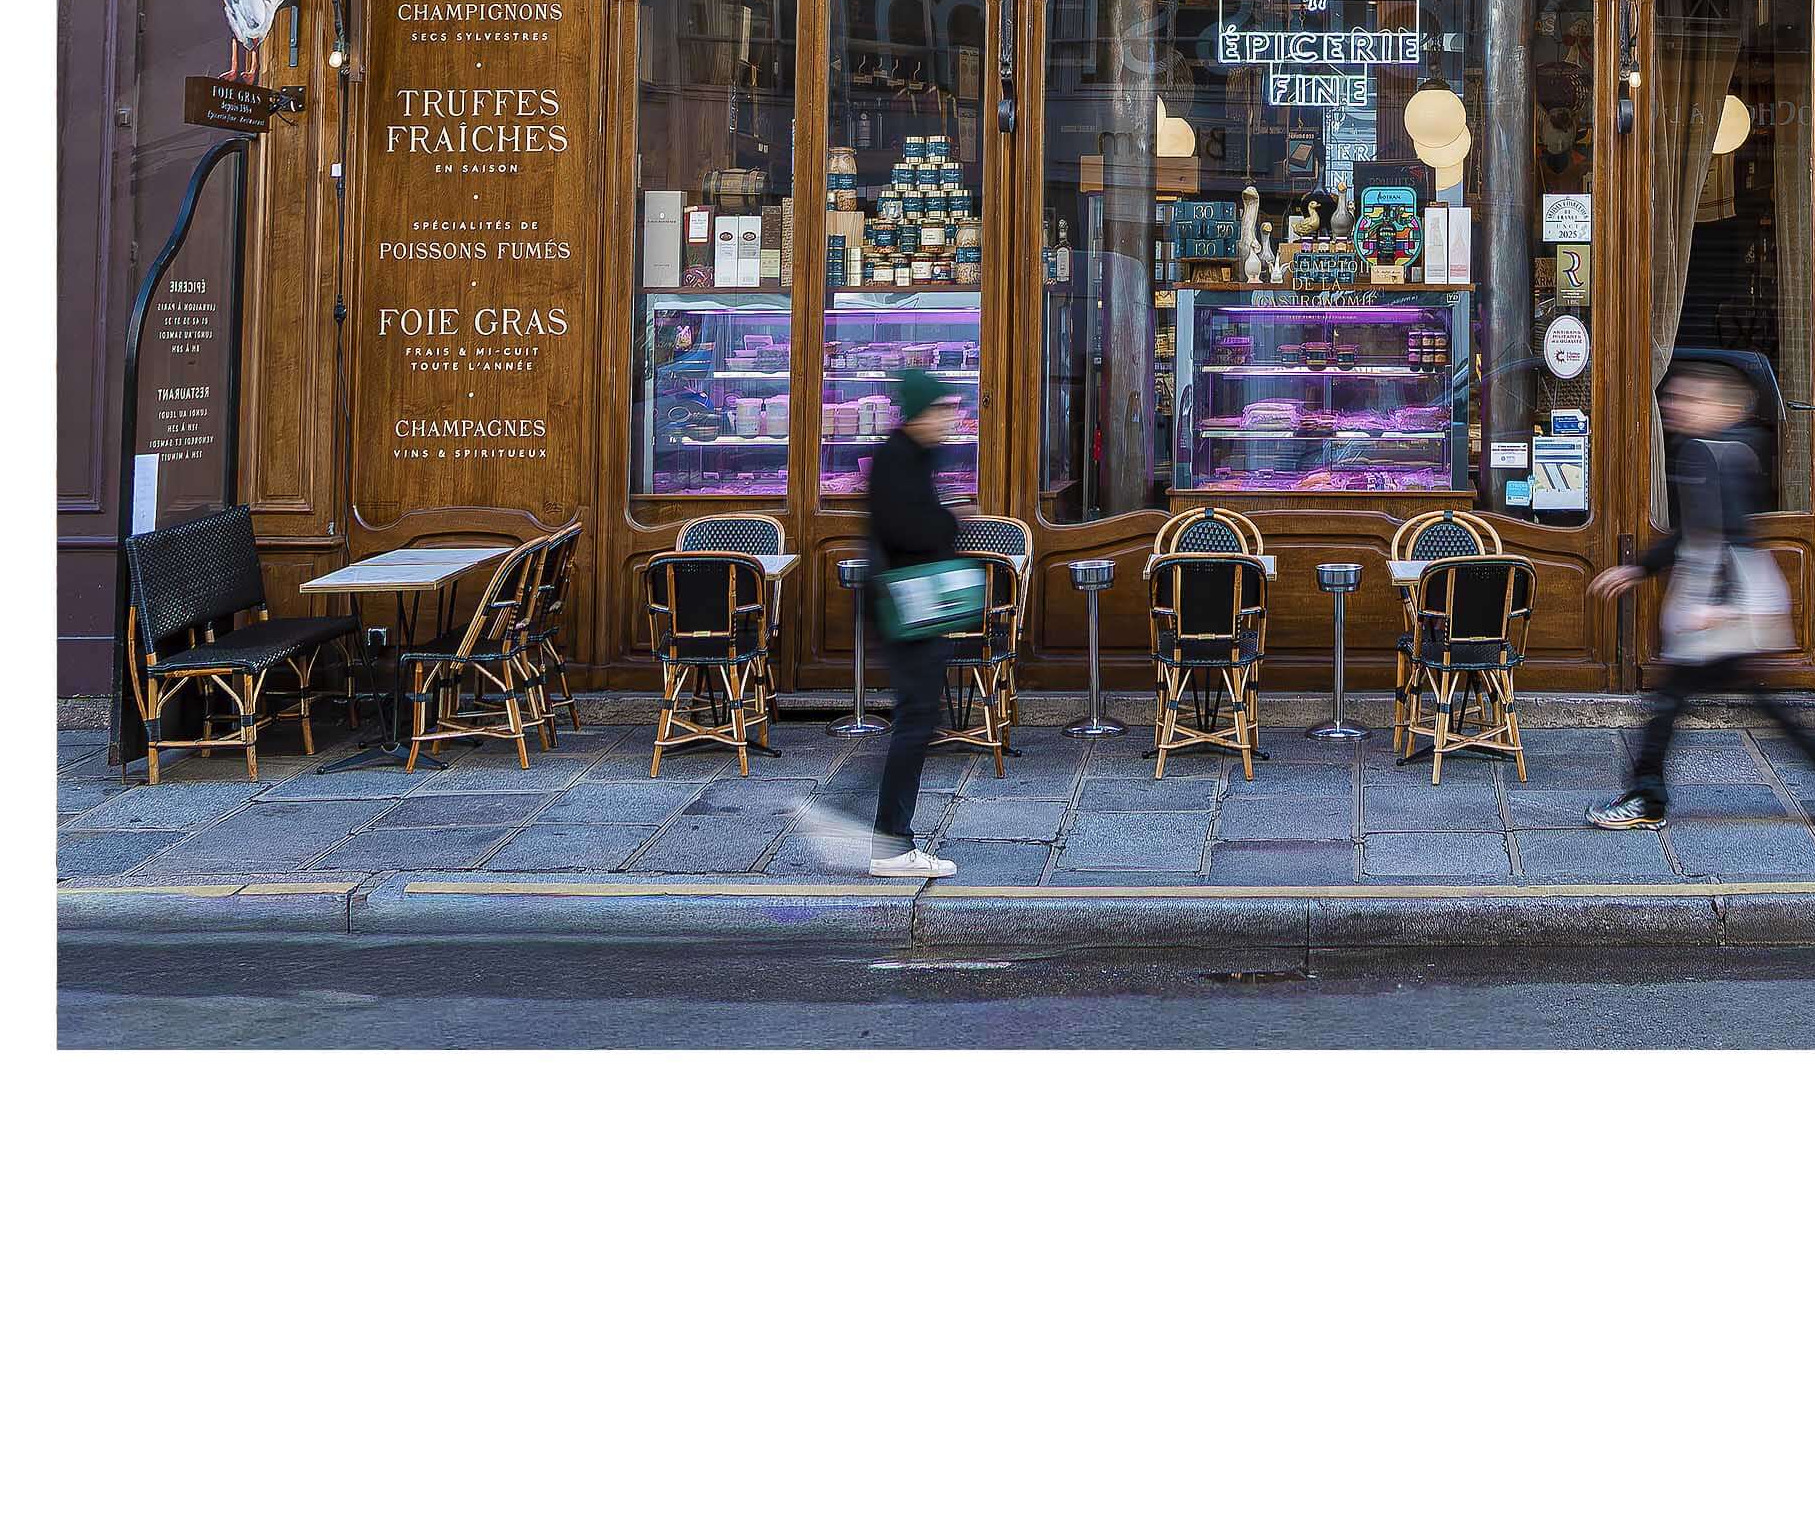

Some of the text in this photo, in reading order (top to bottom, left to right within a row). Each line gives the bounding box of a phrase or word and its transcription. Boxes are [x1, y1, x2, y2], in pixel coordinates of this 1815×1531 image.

[398, 3, 563, 21] CHAMPIGNONS
[411, 31, 549, 42] SECS SYLVESTRES
[1220, 24, 1419, 64] ÉPICERIE
[1270, 74, 1368, 107] FINE
[397, 89, 560, 118] TRUFFES
[386, 122, 568, 155] FRAÎCHES
[435, 164, 519, 173] EN SAISON
[413, 219, 539, 231] SPÉCIALITÉS DE
[1558, 230, 1578, 239] 2025
[379, 238, 571, 260] POISSONS FUMÉS
[1292, 277, 1342, 291] DE LA
[378, 308, 569, 337] FOIE GRAS
[405, 347, 540, 357] FRAIS & MI-CUIT
[410, 359, 534, 371] TOUTE L'ANNÉE
[395, 419, 547, 438] CHAMPAGNES
[393, 449, 547, 459] VINS & SPIRITUEUX
